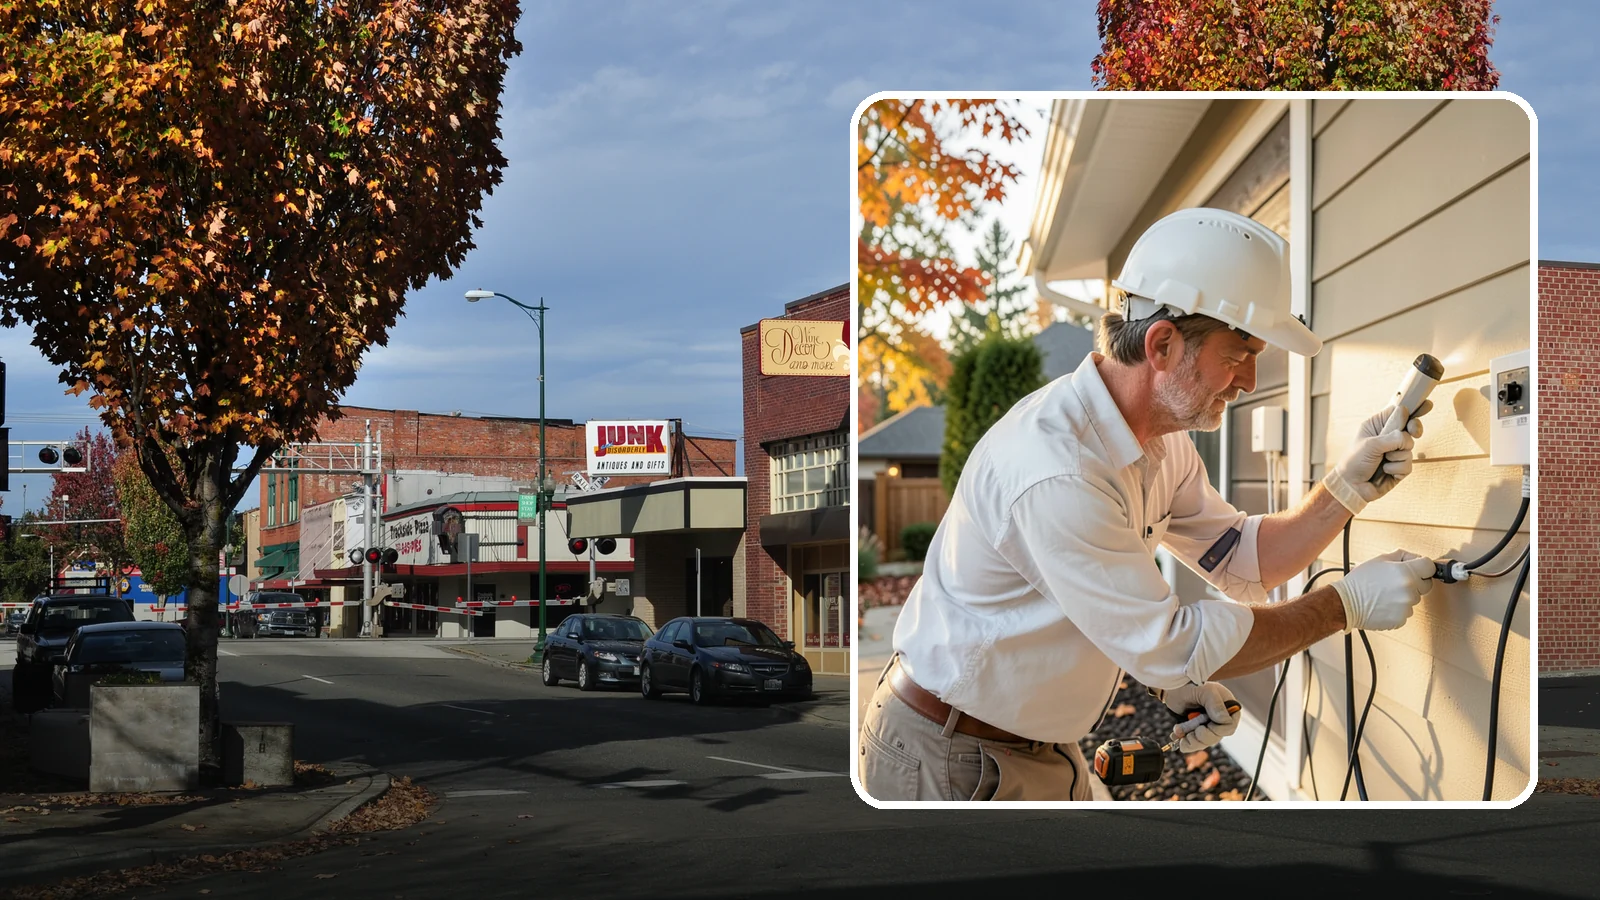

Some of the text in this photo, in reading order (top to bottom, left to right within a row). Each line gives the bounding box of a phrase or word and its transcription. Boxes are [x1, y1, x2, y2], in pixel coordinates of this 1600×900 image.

[765, 328, 831, 365] Decor
[595, 425, 665, 457] JUNK
[607, 446, 646, 454] DISORDERLY
[597, 460, 666, 470] ANTIQUES AND GIFTS
[390, 519, 429, 539] Trackside Pizza
